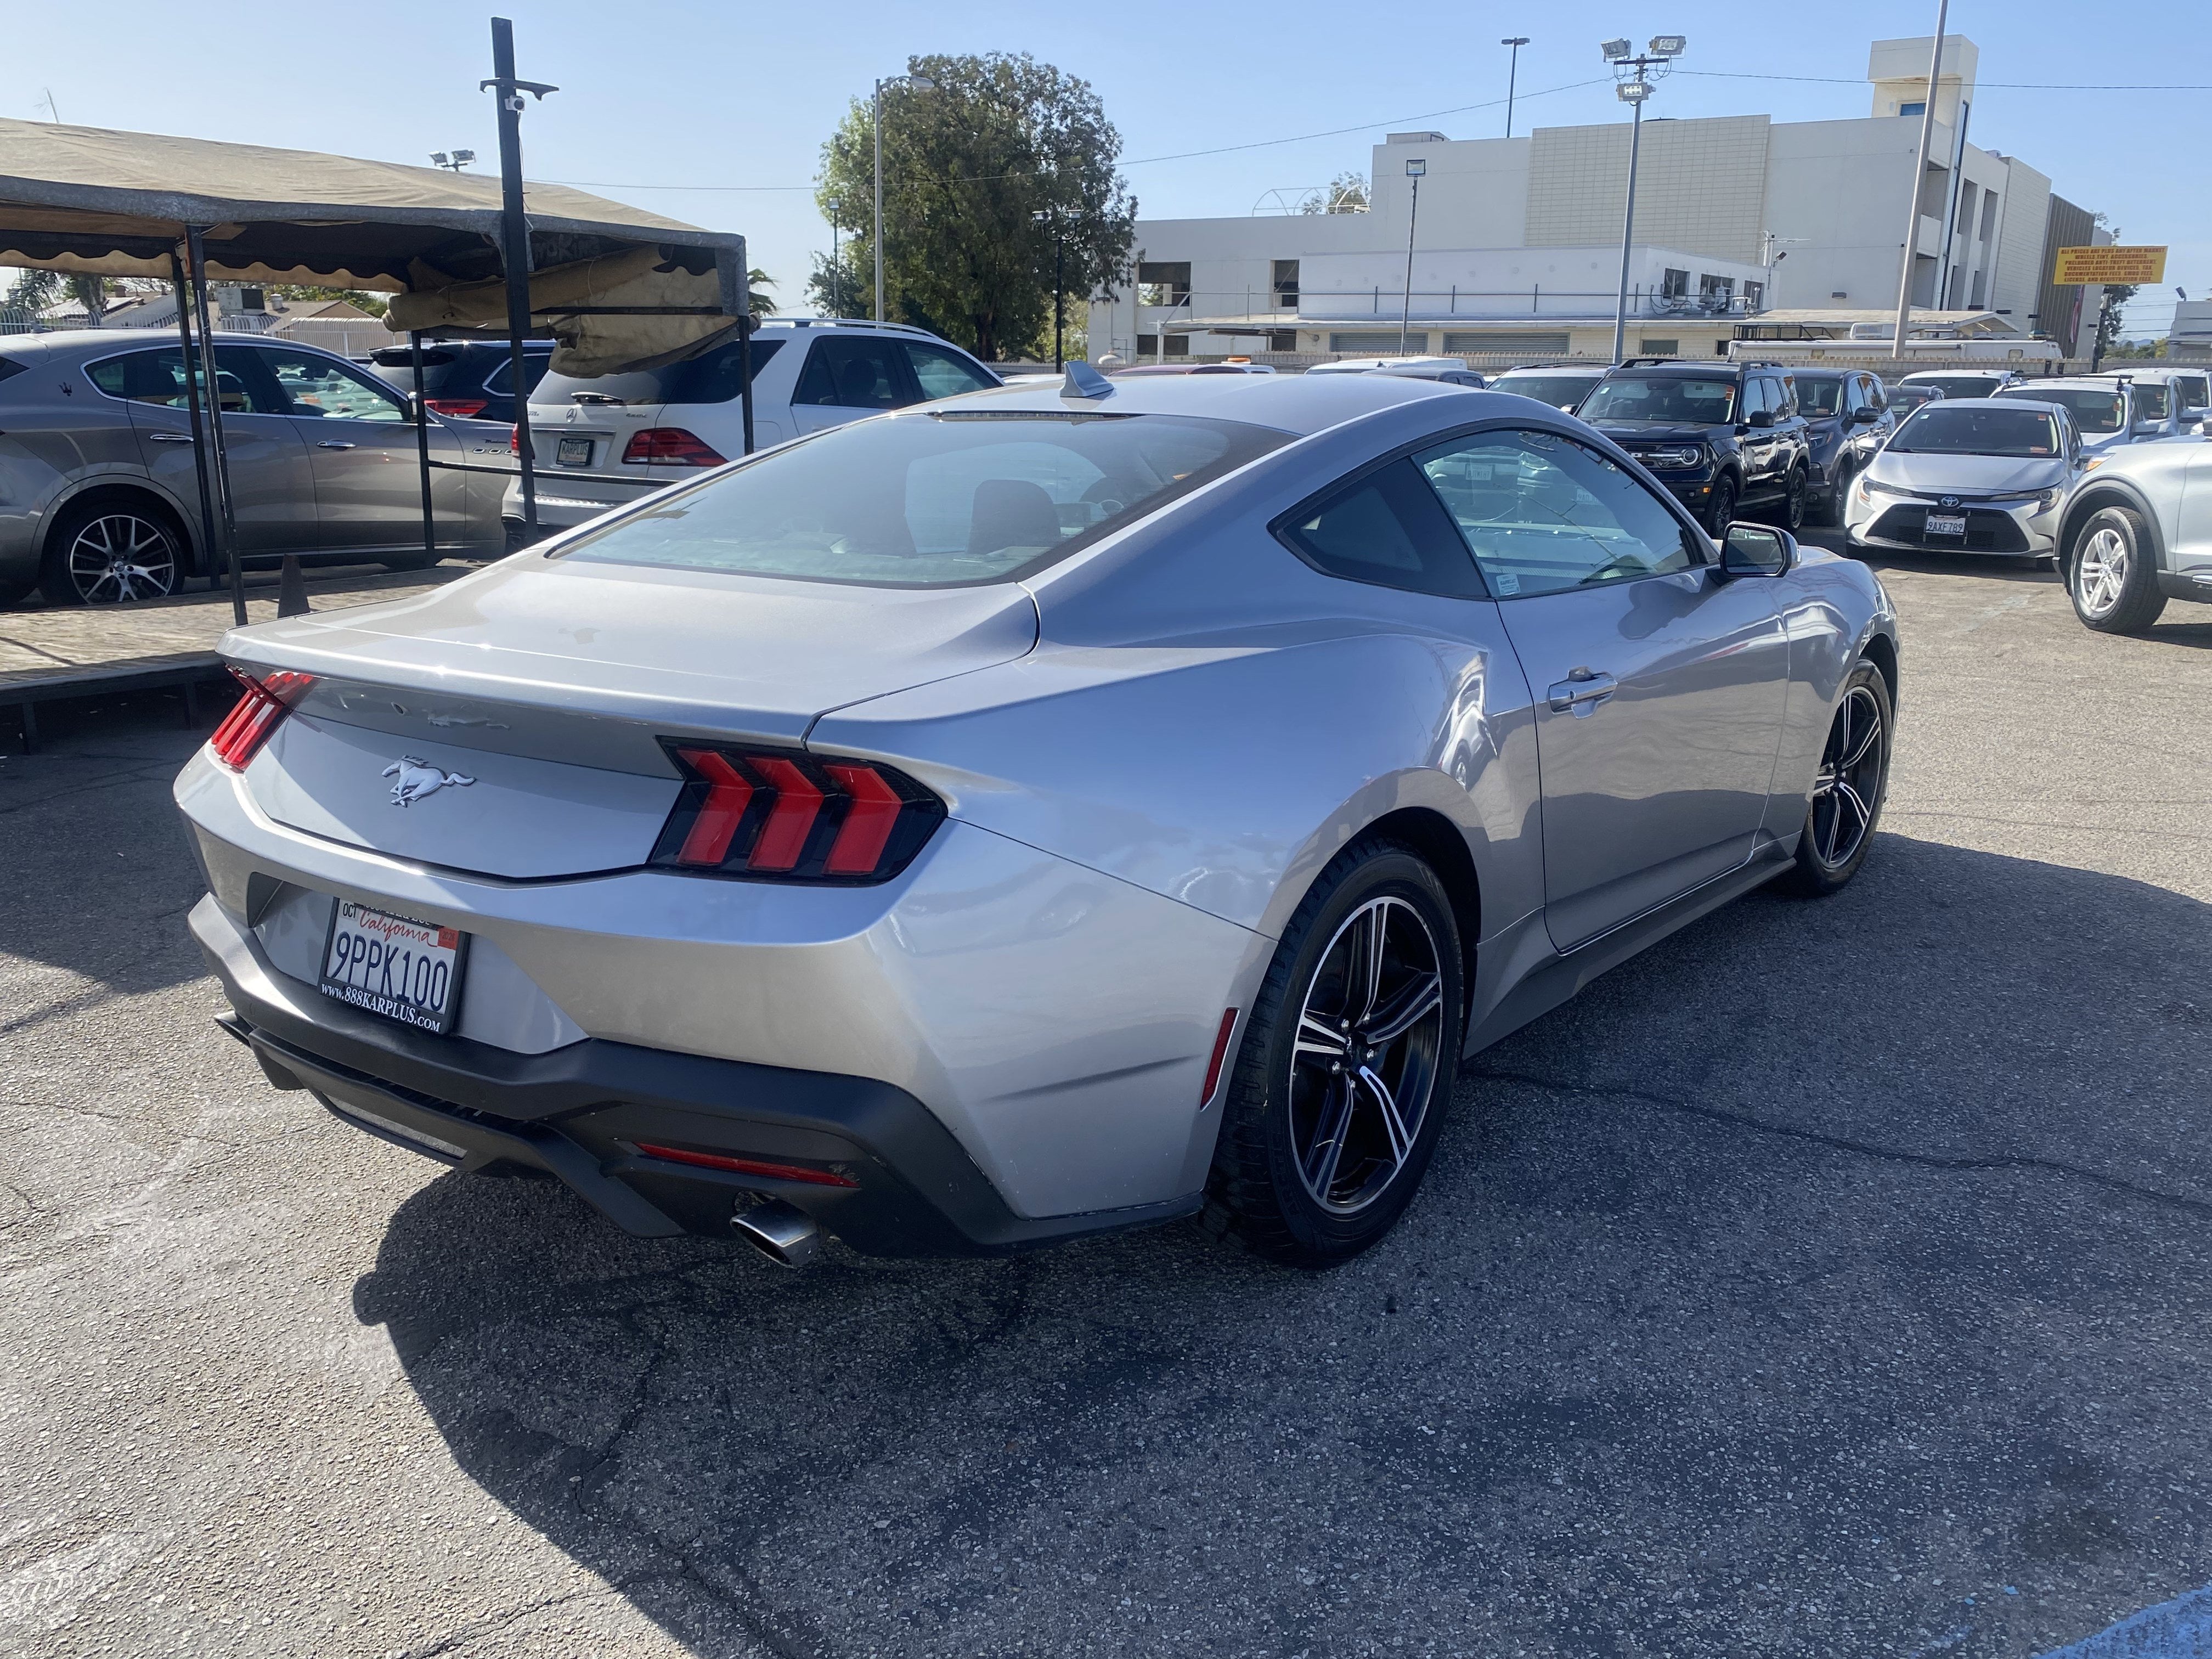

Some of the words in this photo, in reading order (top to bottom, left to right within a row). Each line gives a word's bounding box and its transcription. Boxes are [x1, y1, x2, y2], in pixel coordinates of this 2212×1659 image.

[562, 443, 588, 455] KARPLUS
[343, 902, 357, 918] OCT
[360, 910, 438, 947] California
[331, 932, 448, 1012] 9PPK100
